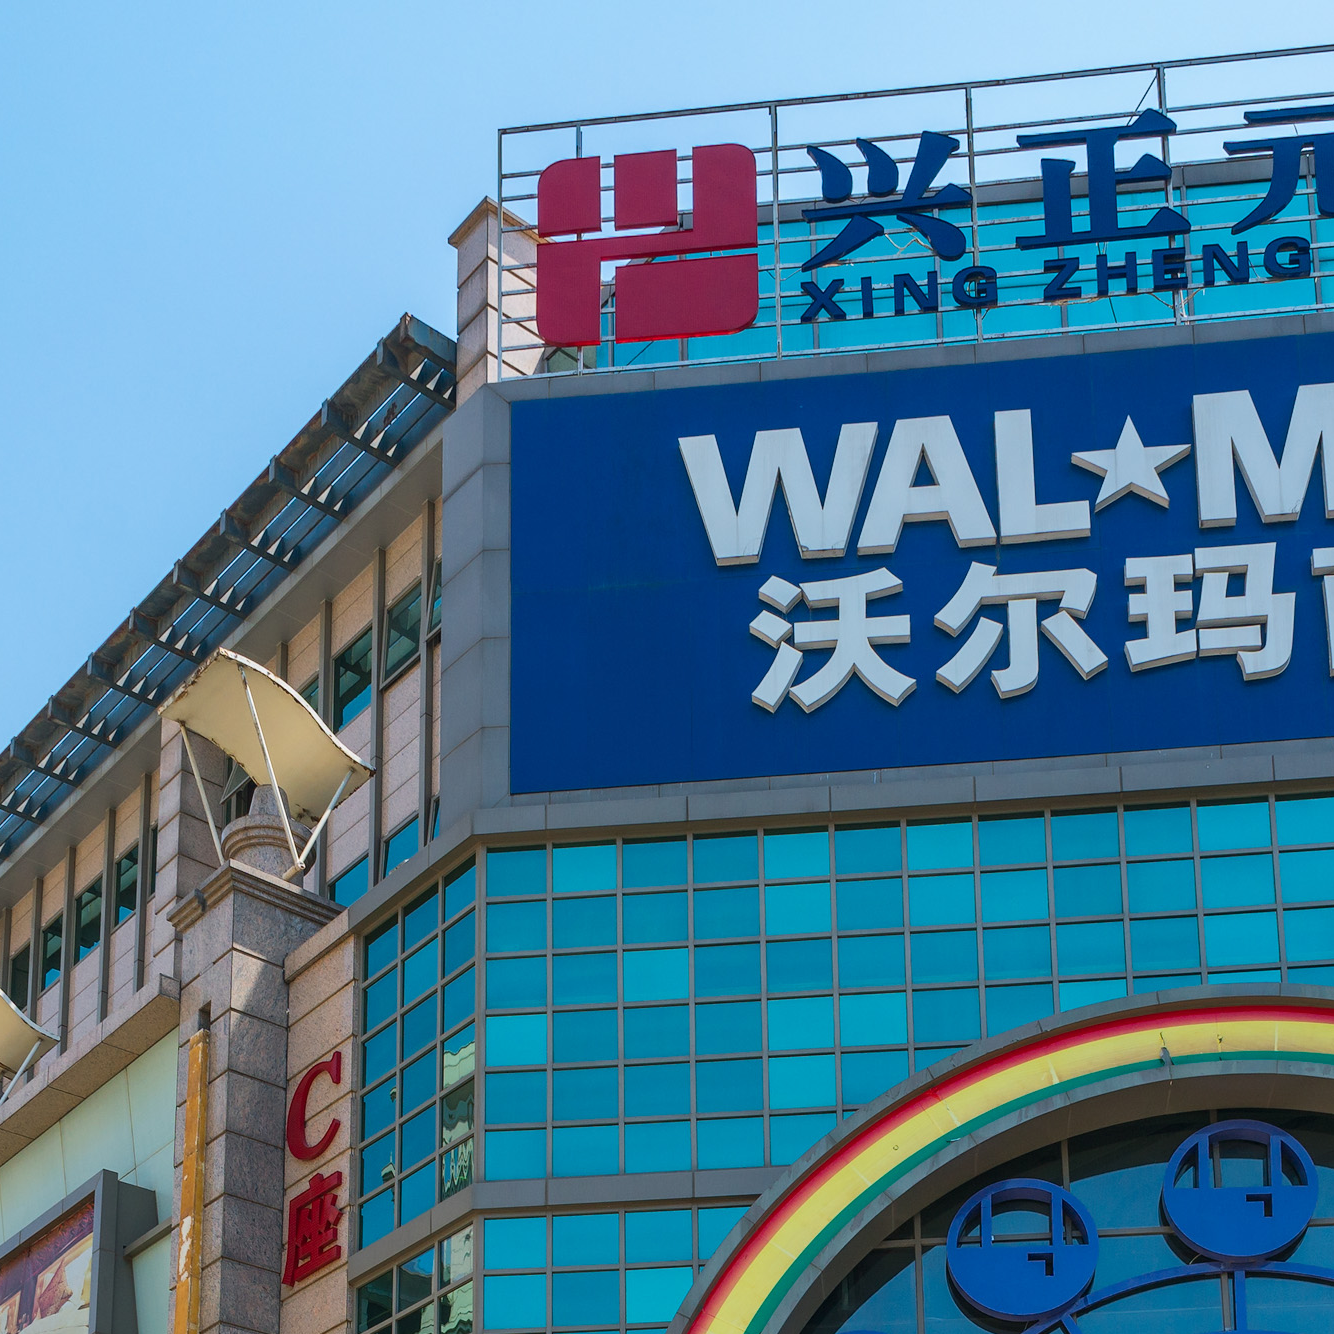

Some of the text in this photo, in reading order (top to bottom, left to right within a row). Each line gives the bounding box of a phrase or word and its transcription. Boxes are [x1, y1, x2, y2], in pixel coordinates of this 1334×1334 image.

[800, 264, 999, 324] XING
[1043, 235, 1315, 304] ZHENG
[282, 1051, 343, 1287] C座
